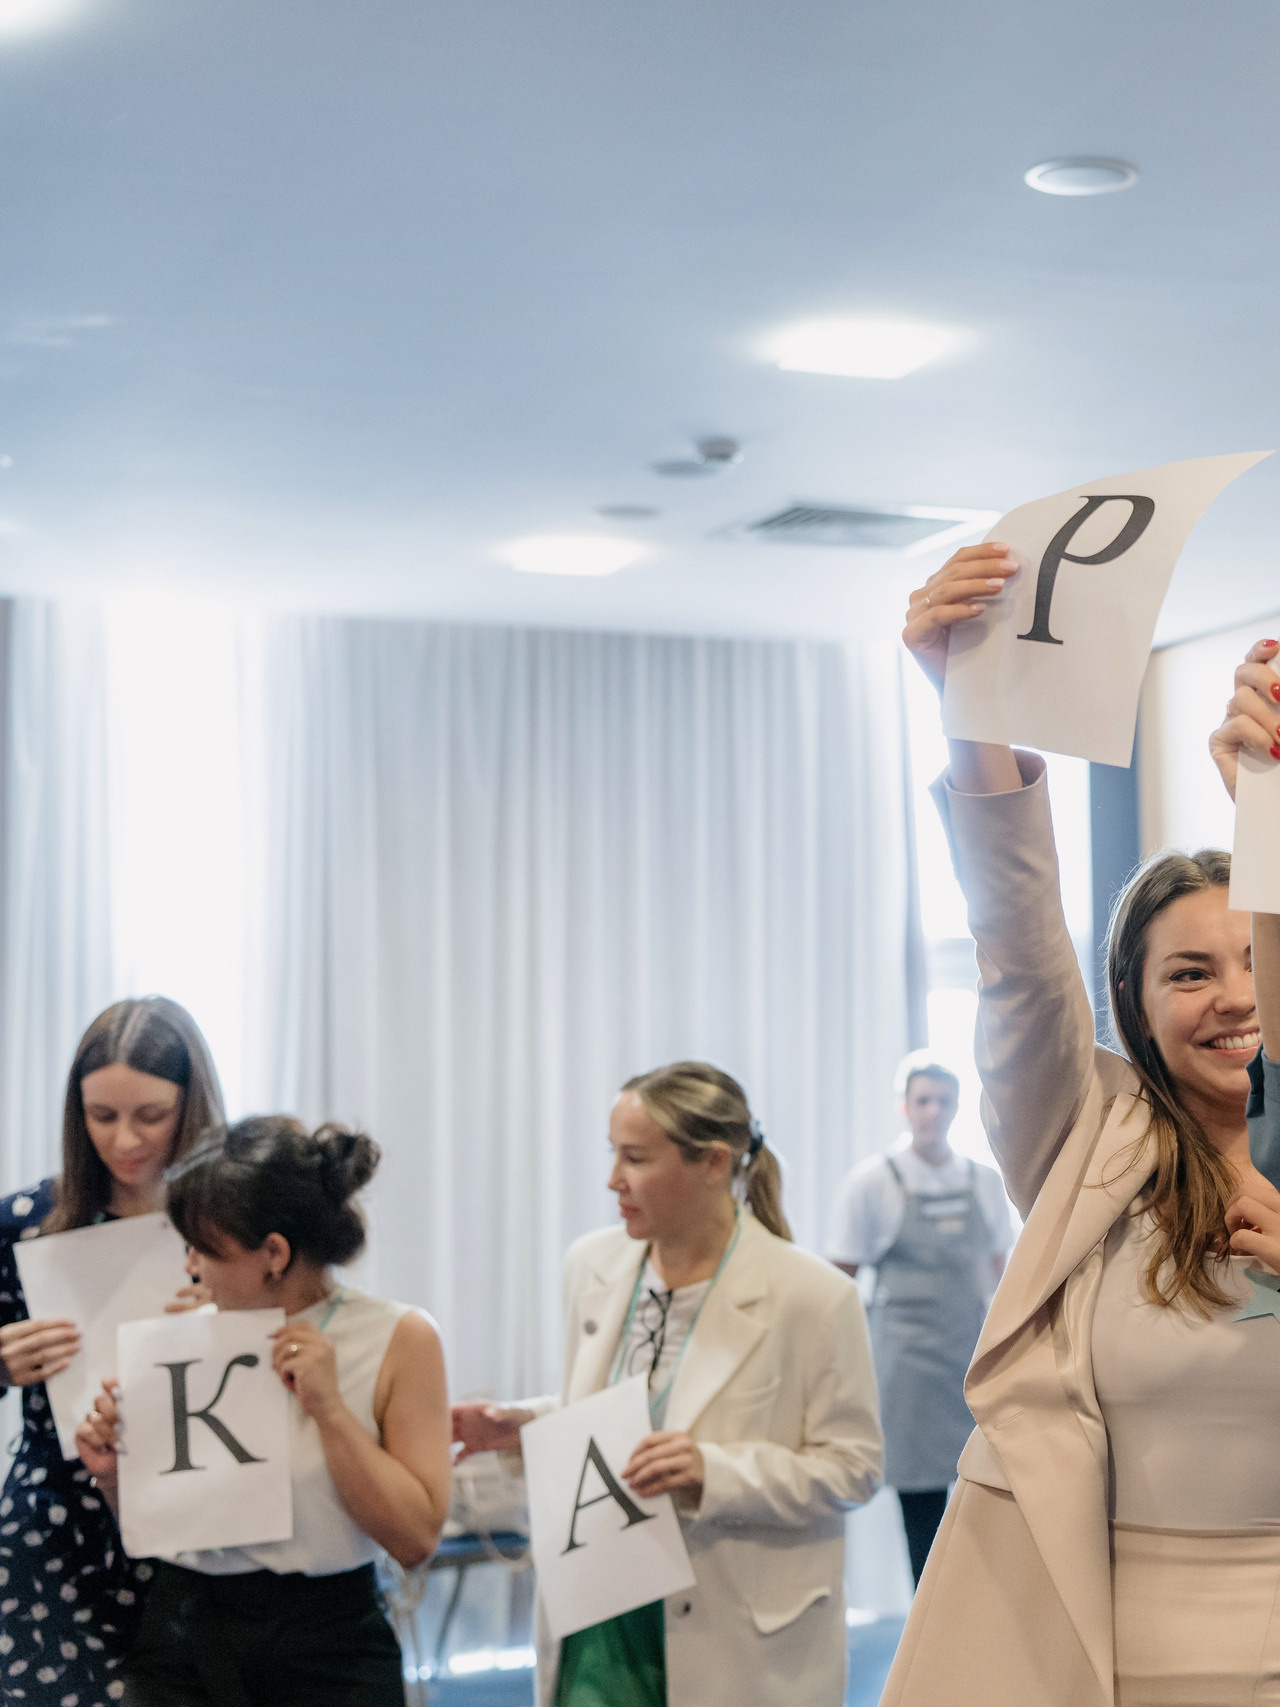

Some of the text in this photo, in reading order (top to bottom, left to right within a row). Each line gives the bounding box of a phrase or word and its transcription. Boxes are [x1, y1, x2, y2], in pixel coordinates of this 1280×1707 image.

[1016, 494, 1155, 645] Р
[155, 1353, 268, 1476] К
[561, 1436, 657, 1556] А
